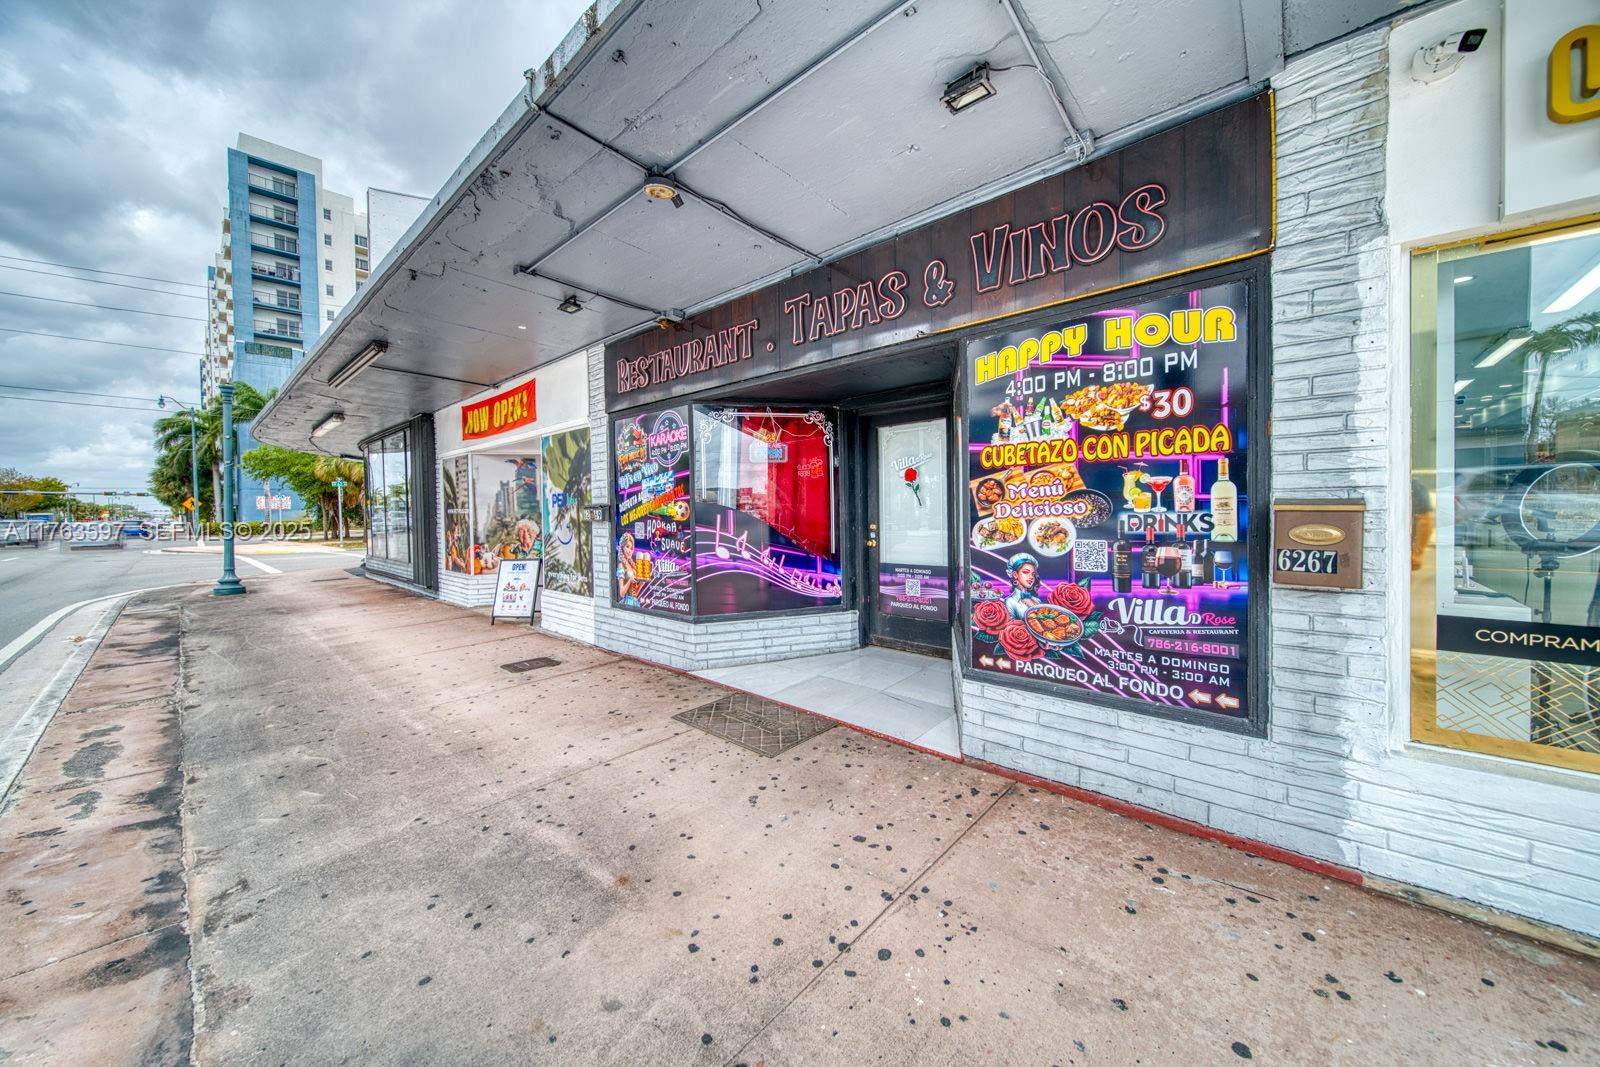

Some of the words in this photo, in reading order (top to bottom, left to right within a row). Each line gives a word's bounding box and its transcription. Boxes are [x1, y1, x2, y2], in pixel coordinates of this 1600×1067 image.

[617, 319, 760, 393] RESTAURANT
[785, 270, 908, 344] TAPAS
[923, 260, 954, 306] &
[970, 183, 1168, 293] VINOS
[975, 323, 1088, 385] HAPPY
[1103, 306, 1236, 351] HOUR
[1005, 374, 1047, 398] 4:00
[1054, 369, 1082, 391] PM
[1103, 356, 1153, 383] 8:00
[1164, 349, 1198, 374] PM
[465, 405, 489, 434] NOW
[493, 390, 528, 428] OPEN!
[1139, 387, 1193, 419] $30
[651, 427, 687, 447] KARAOKE
[981, 438, 1077, 468] CUBETAZO
[1082, 432, 1130, 461] CON
[1136, 423, 1232, 457] PICADA
[1007, 478, 1064, 500] Menú
[993, 500, 1088, 519] Delicioso
[647, 520, 677, 540] HOOKAH
[1127, 513, 1215, 533] DRINKS
[661, 538, 685, 552] SUAVE
[1278, 549, 1337, 573] 6267
[675, 602, 689, 612] FONDO
[891, 601, 912, 609] PARQUEO
[920, 604, 938, 612] FONDO
[1108, 597, 1190, 625] Villa
[1201, 612, 1236, 625] Rose
[1147, 638, 1236, 656] 786-216-8001
[1475, 629, 1600, 652] COMPRAM
[1094, 647, 1143, 662] MARTES
[1148, 655, 1156, 664] A
[1161, 656, 1230, 674] DOMINGO
[1015, 660, 1088, 683] PARQUEO
[1092, 673, 1114, 688] AL
[1119, 676, 1184, 700] FONDO
[1108, 660, 1136, 672] 3:00
[1140, 665, 1158, 676] PM
[1172, 670, 1203, 683] 3:00
[1209, 676, 1230, 687] AM
